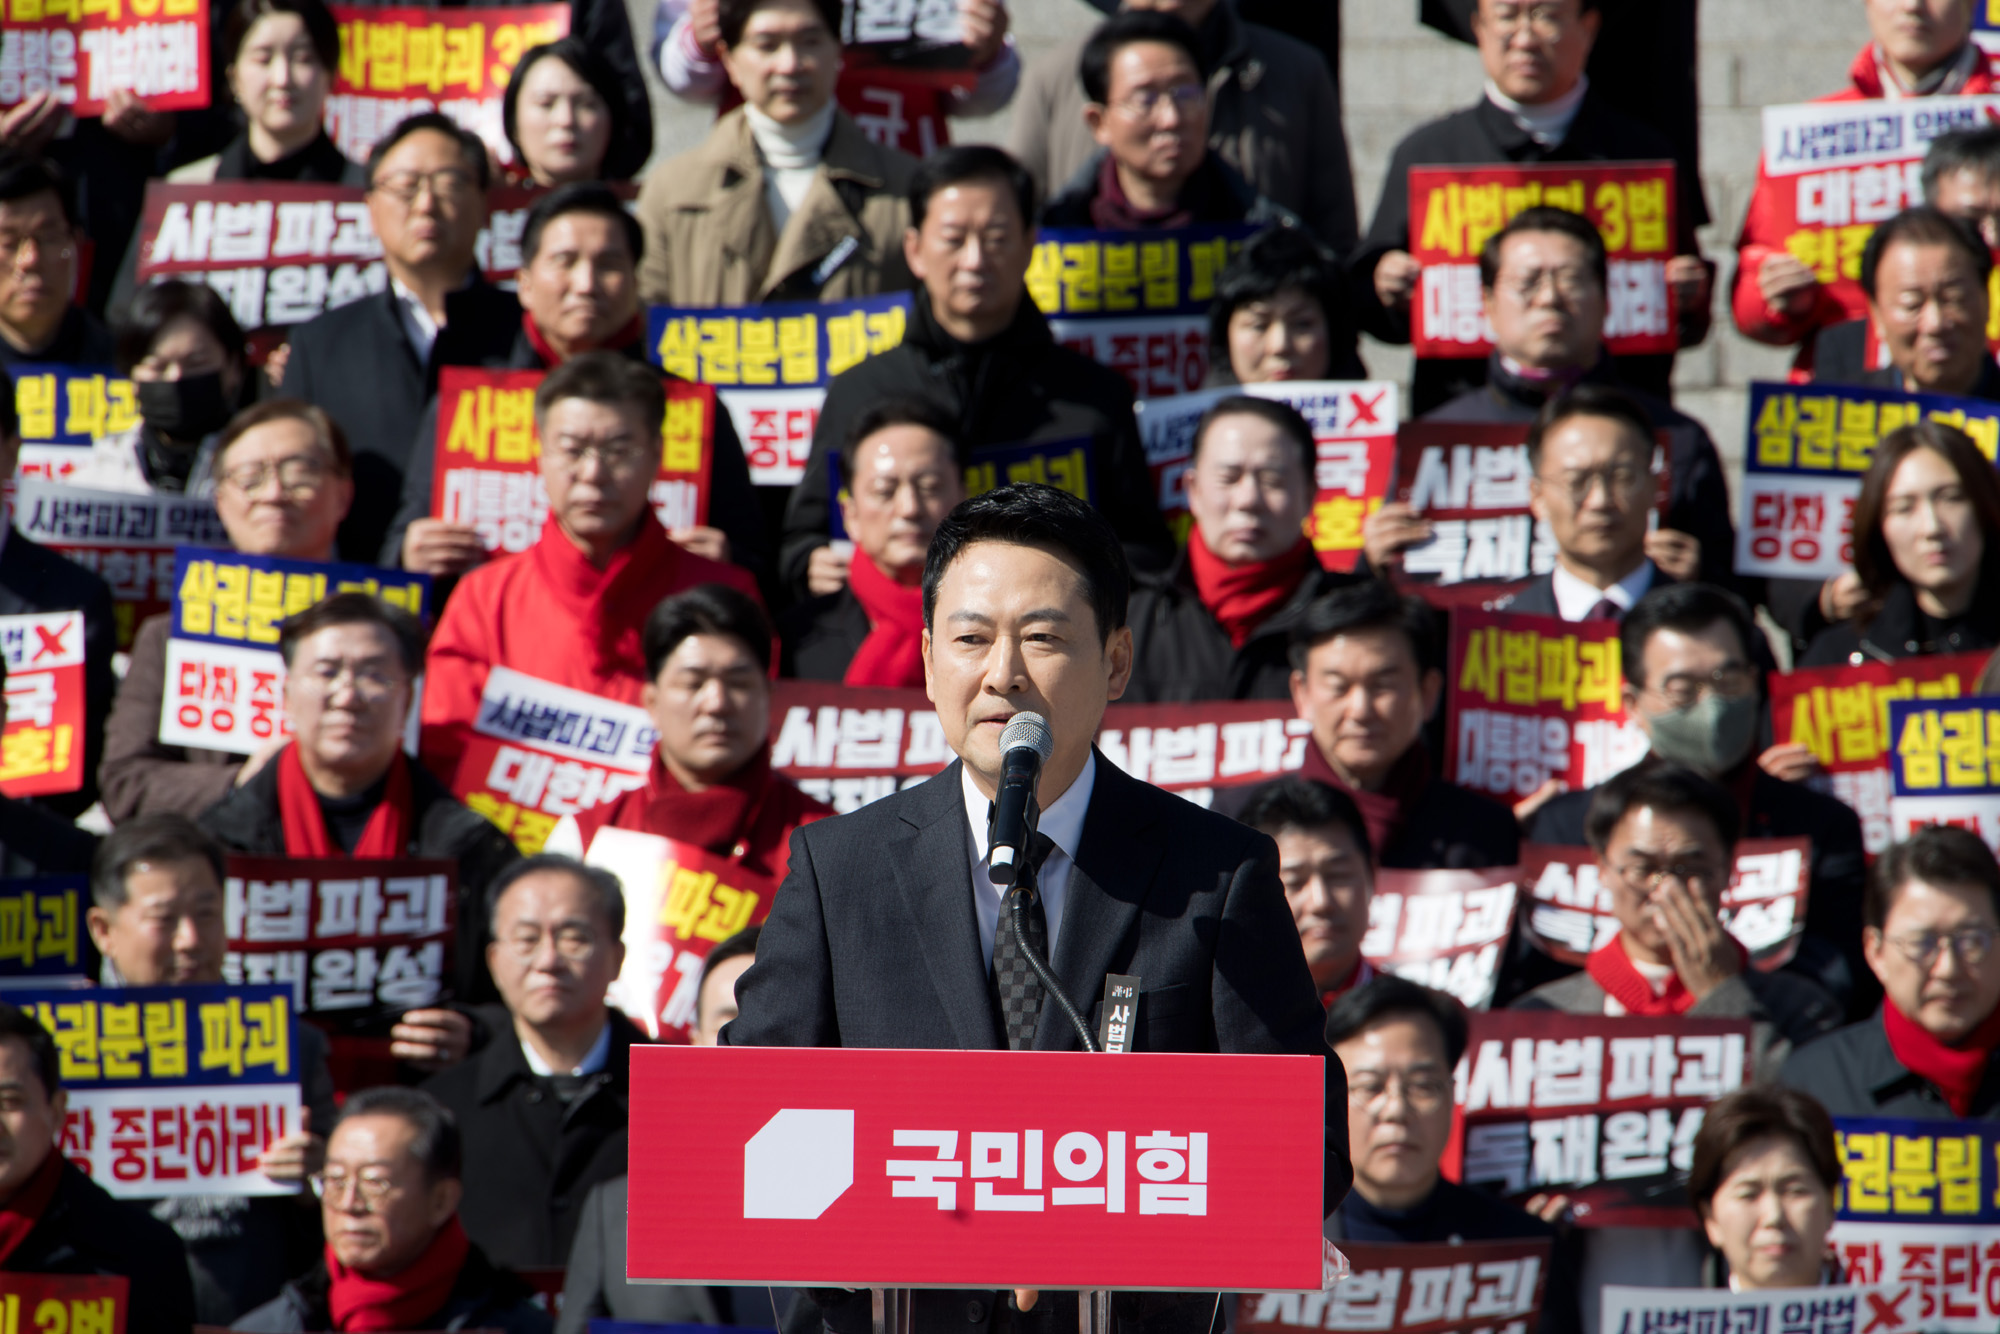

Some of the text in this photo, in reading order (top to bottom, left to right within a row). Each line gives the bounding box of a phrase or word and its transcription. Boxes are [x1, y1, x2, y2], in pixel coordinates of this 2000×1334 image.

[1779, 114, 1902, 161] 사법파괴
[1593, 177, 1668, 252] 3법
[656, 314, 819, 384] 삼권분립
[446, 385, 542, 464] 사법
[29, 498, 159, 541] 사법파괴
[1749, 490, 1827, 563] 당장
[177, 661, 239, 733] 당장
[1458, 625, 1624, 714] 사법파괴
[485, 692, 633, 757] 사법파괴
[1787, 672, 1961, 766] 사법
[25, 995, 291, 1080] 권분립 파괴
[885, 1129, 1209, 1217] 국민의힘
